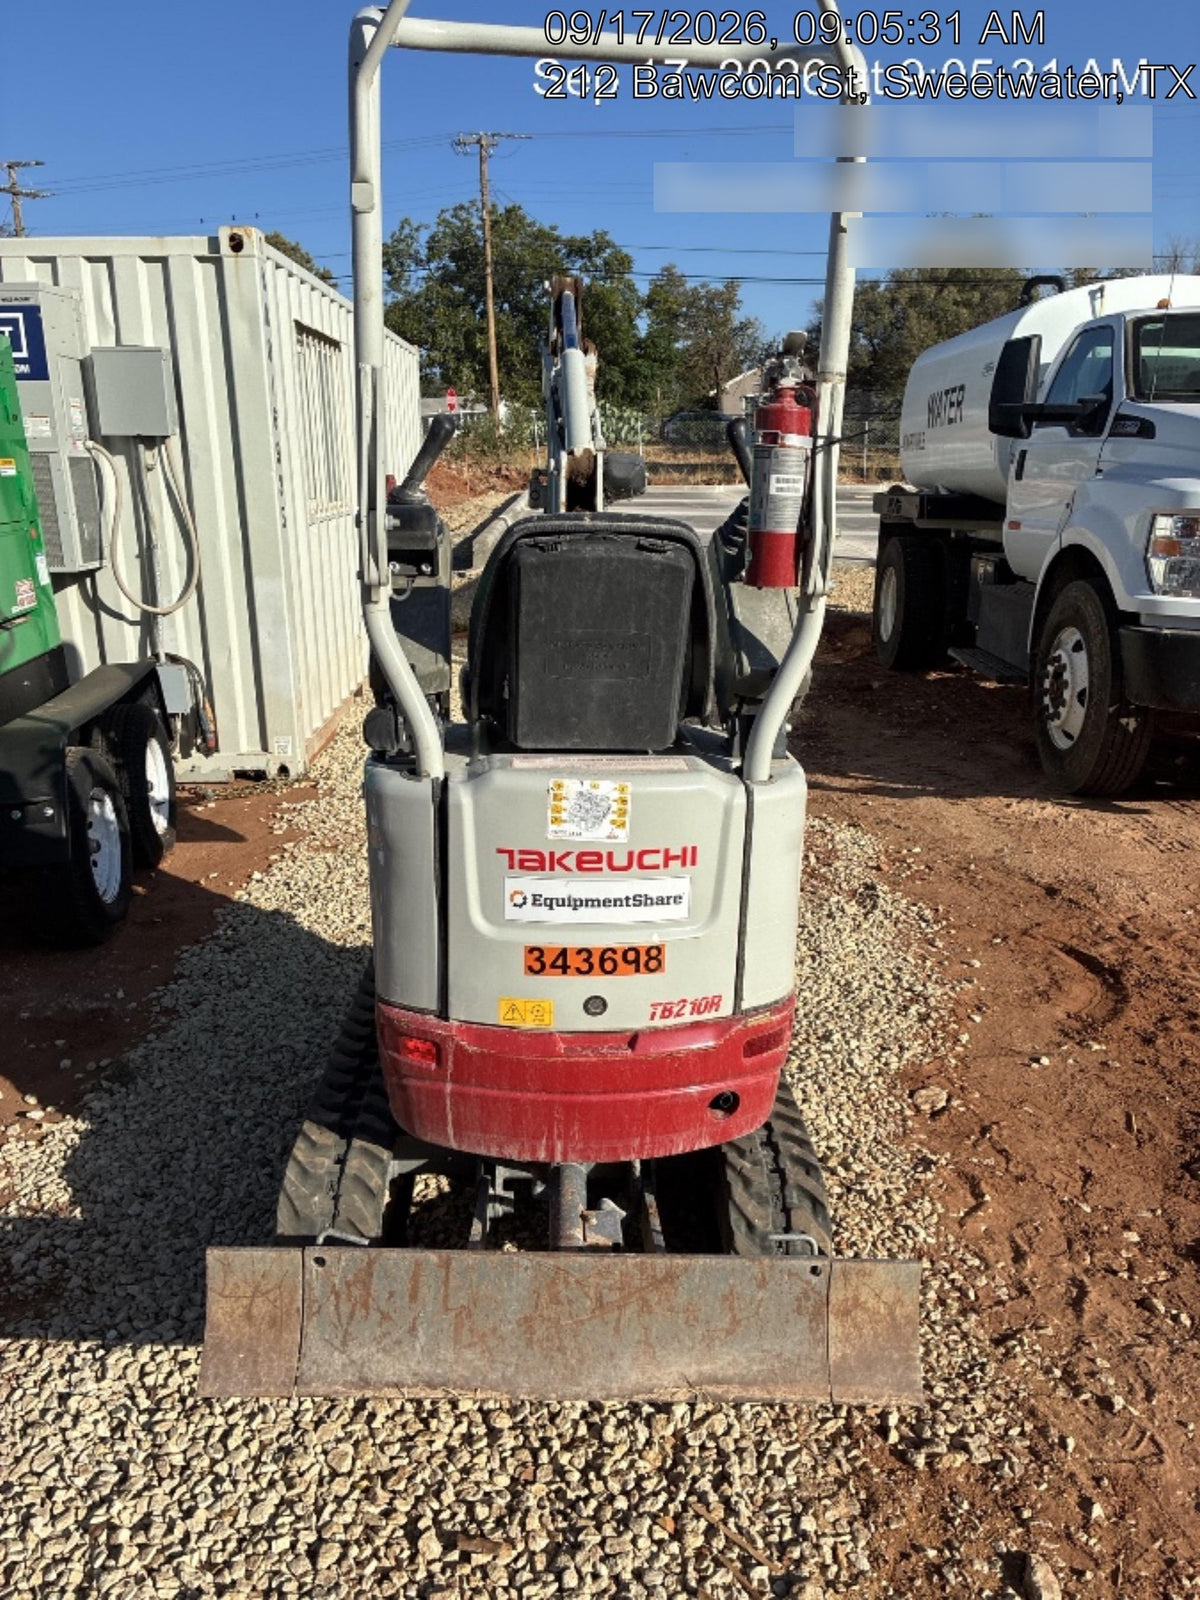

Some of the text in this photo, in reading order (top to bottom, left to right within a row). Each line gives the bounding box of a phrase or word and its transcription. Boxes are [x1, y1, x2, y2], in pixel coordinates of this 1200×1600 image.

[927, 384, 966, 429] WATER
[530, 892, 684, 911] EquipmentShare
[527, 945, 663, 975] 343698
[650, 995, 723, 1021] TB210R
